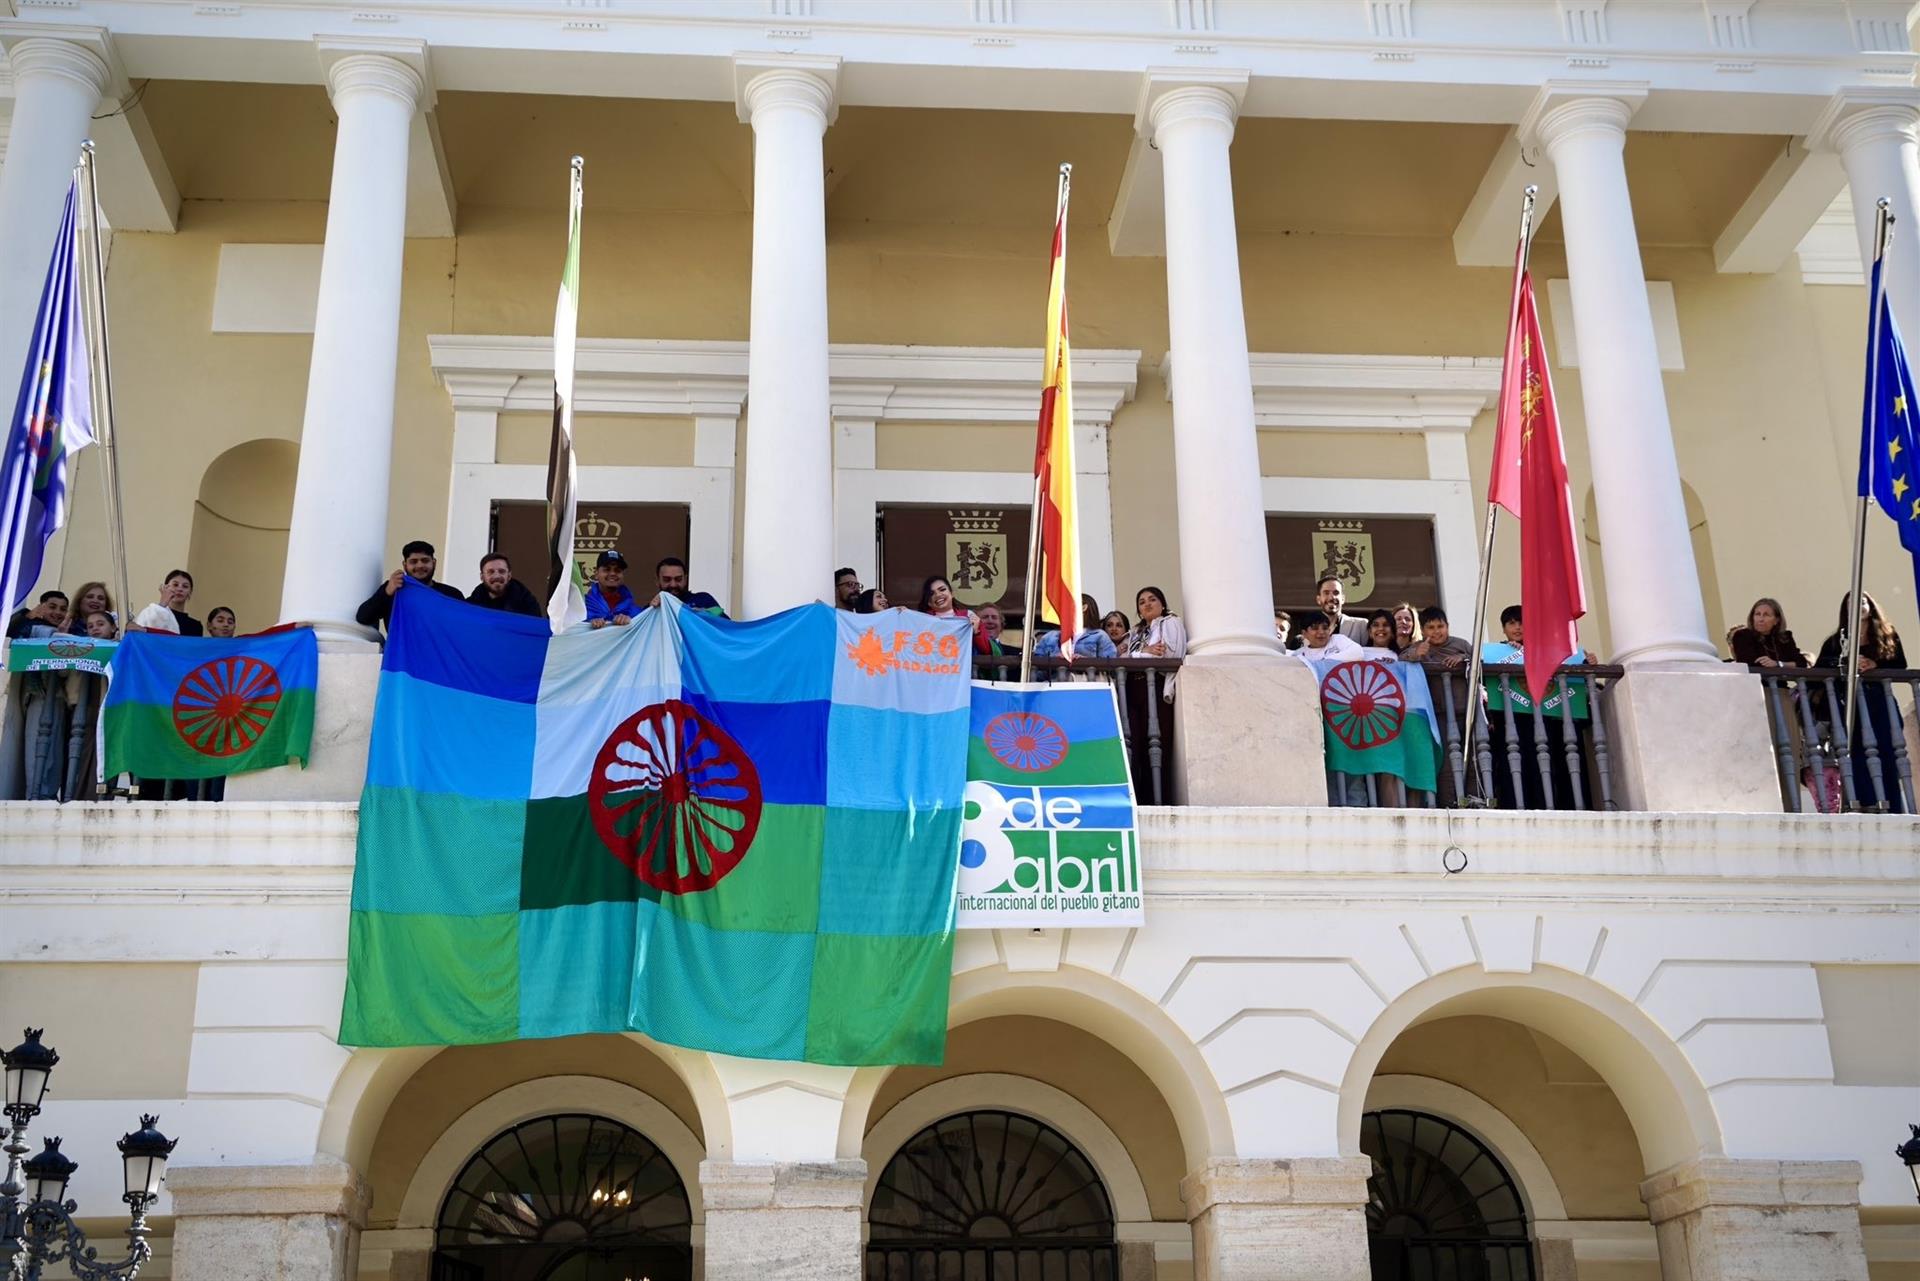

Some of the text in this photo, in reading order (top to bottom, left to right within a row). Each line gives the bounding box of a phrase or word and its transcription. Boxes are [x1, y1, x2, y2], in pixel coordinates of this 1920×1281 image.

[893, 631, 960, 659] FSG
[1006, 787, 1082, 829] de
[1007, 830, 1132, 894] abril
[959, 893, 1140, 913] internacional del pueblo gitano
